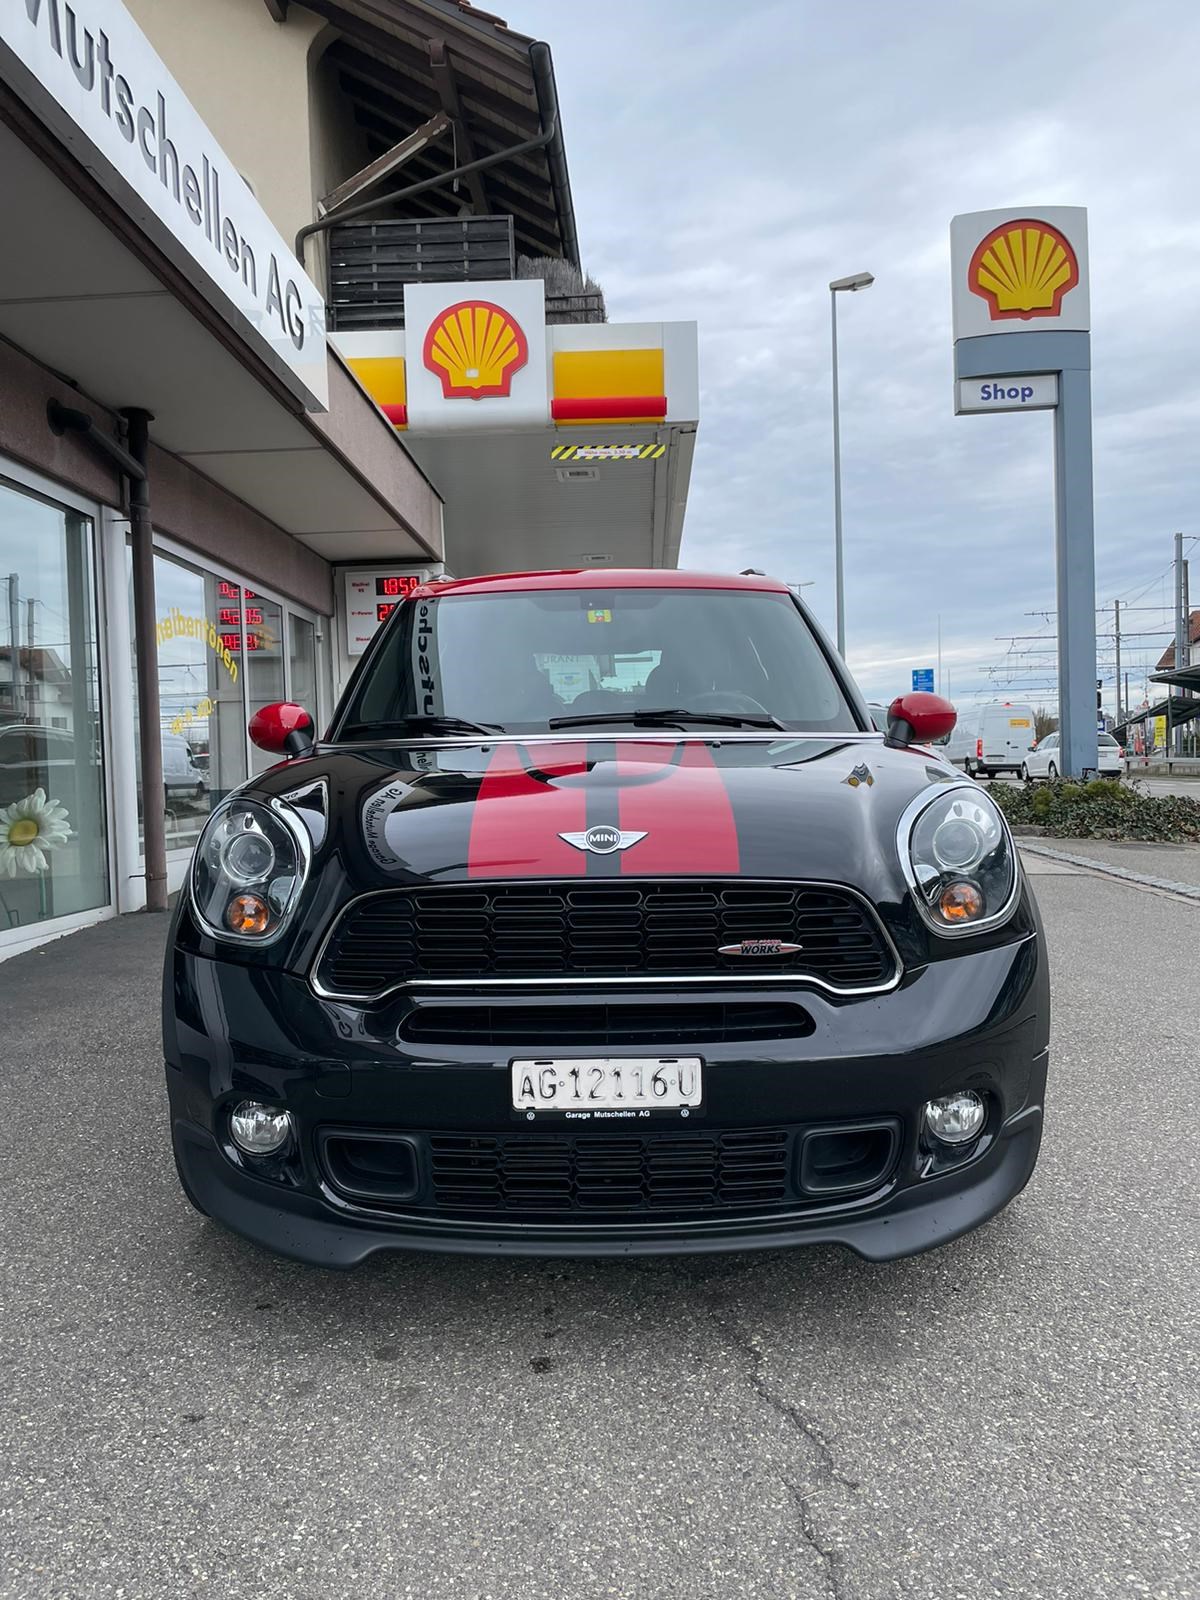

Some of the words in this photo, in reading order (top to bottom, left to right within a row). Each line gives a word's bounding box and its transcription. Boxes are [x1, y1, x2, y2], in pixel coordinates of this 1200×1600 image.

[266, 252, 304, 351] AG
[981, 383, 1034, 402] Shop
[589, 834, 617, 842] MINI
[741, 945, 780, 954] WORKS
[594, 1110, 636, 1118] Mutschellen
